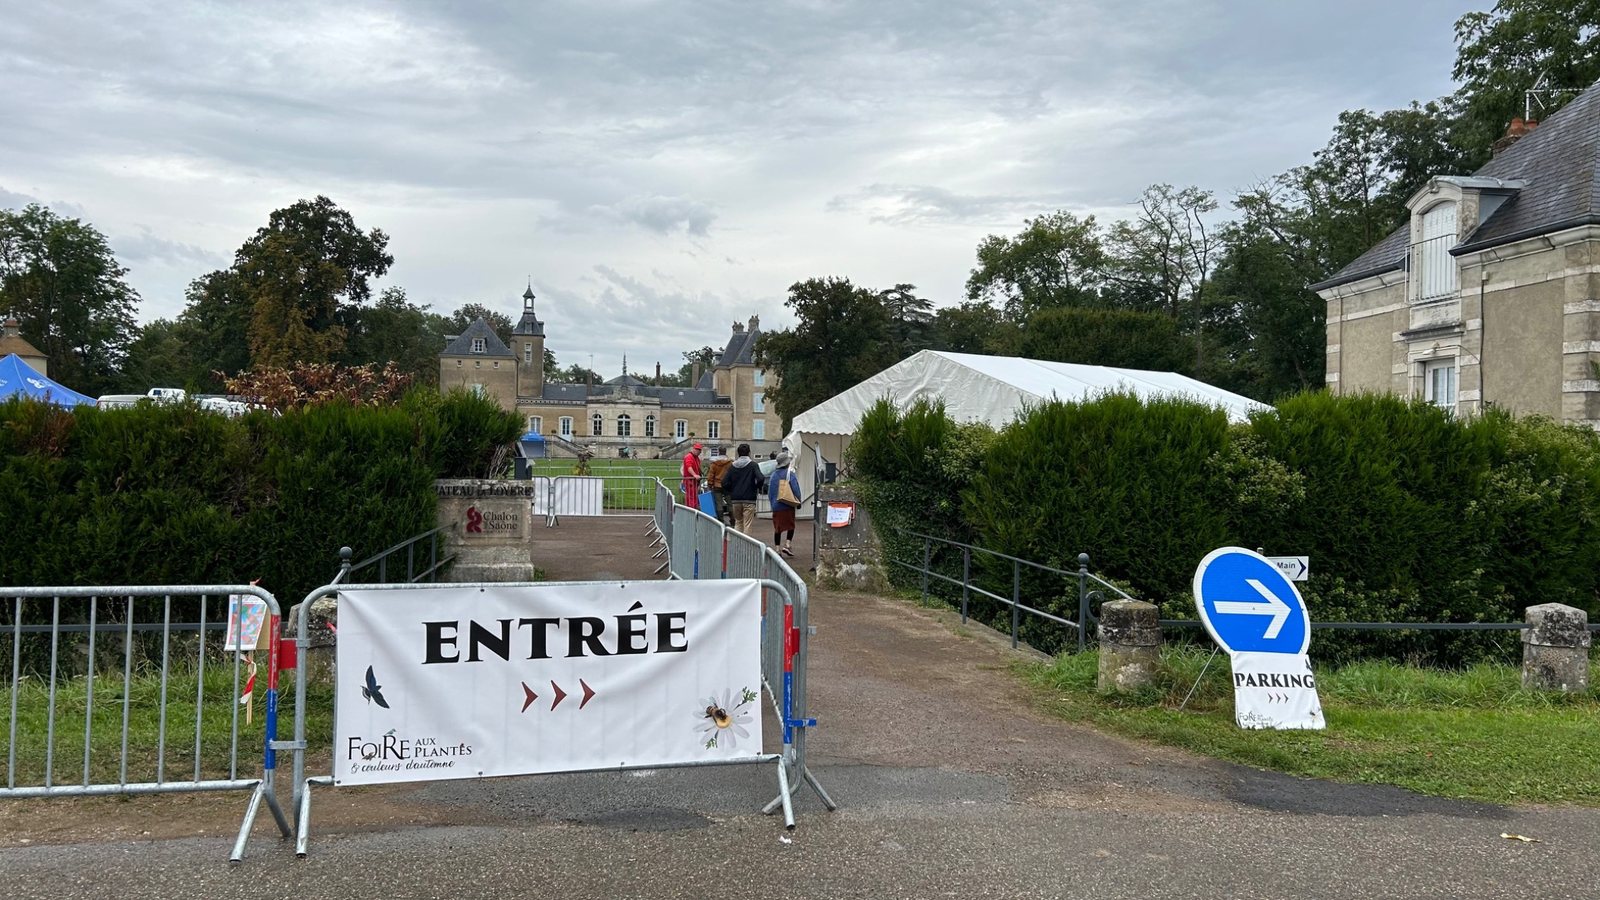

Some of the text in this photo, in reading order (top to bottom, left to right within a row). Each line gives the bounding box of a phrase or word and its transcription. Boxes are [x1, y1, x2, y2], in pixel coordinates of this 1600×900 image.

[483, 511, 518, 521] Chalon
[421, 600, 689, 664] ENTRÉE
[1234, 673, 1315, 688] PARKING
[415, 737, 437, 746] AUX
[361, 760, 400, 772] couleurs
